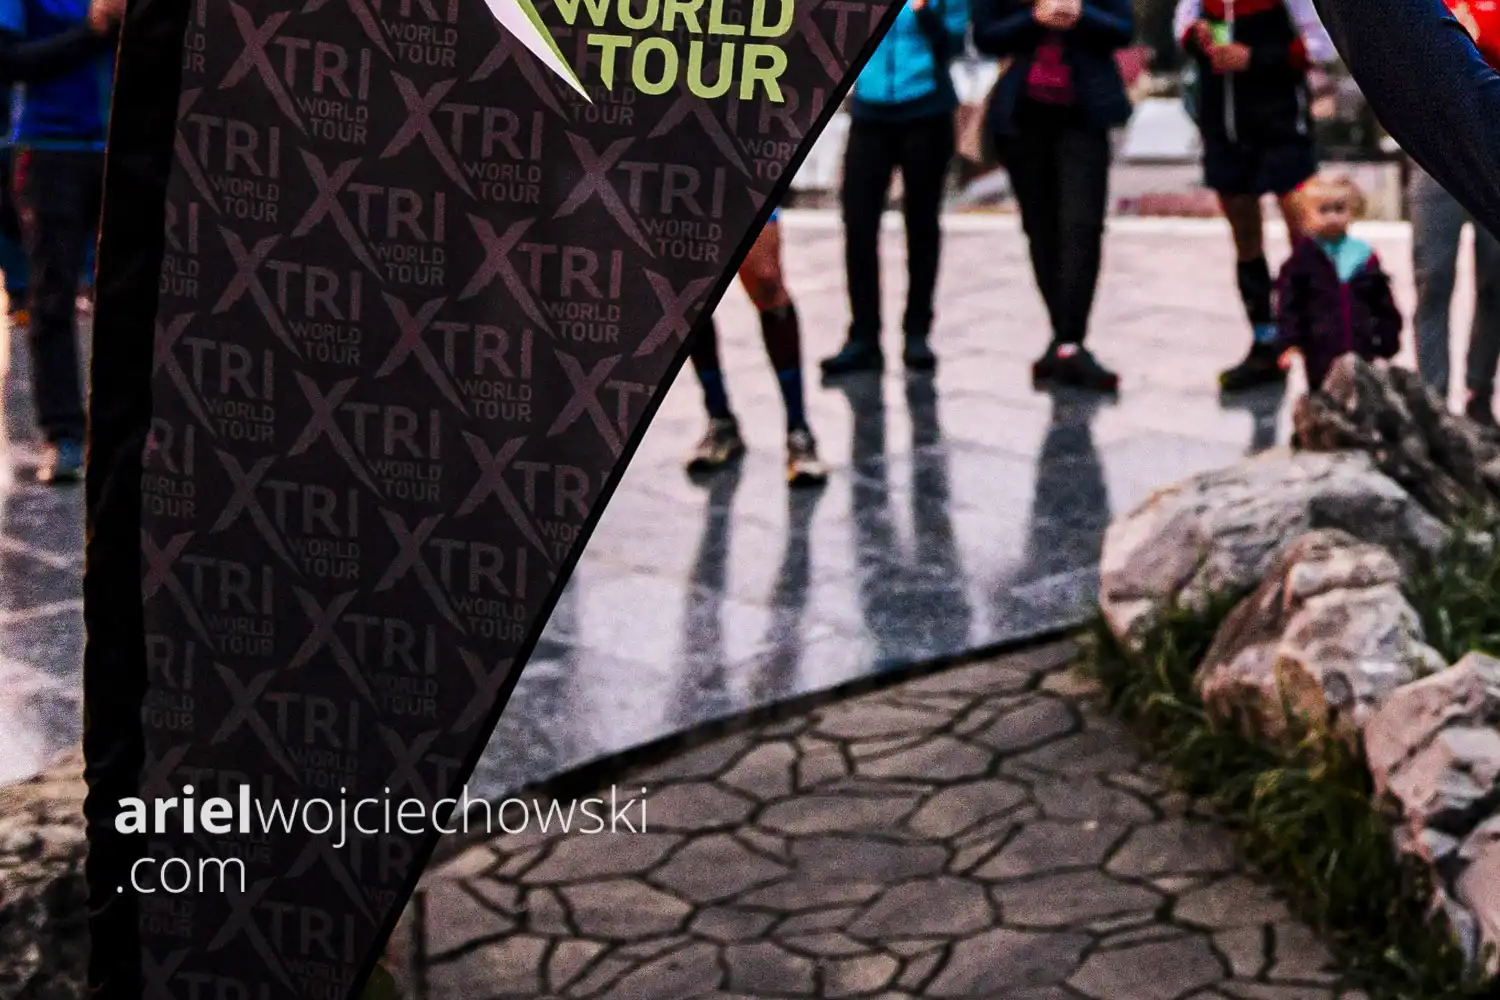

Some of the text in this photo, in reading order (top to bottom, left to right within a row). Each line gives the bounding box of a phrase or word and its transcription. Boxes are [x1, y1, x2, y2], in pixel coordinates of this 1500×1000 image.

[381, 20, 459, 48] WORLD
[394, 42, 457, 68] TOUR
[217, 0, 372, 139] XTRI
[587, 32, 789, 104] TOUR
[296, 97, 369, 124] WORLD
[569, 102, 635, 126] TOUR
[309, 120, 367, 145] TOUR
[378, 68, 544, 203] XTRI
[463, 160, 542, 184] WORLD
[208, 172, 280, 200] WORLD
[476, 181, 540, 205] TOUR
[552, 129, 726, 259] XTRI
[220, 196, 279, 223] TOUR
[290, 150, 446, 283] XTRI
[641, 217, 722, 241] WORLD
[366, 240, 445, 265] WORLD
[655, 239, 720, 262] TOUR
[384, 261, 445, 287] TOUR
[458, 211, 623, 340] XTRI
[210, 222, 362, 360] XTRI
[542, 301, 621, 323] WORLD
[287, 320, 362, 344] WORLD
[558, 321, 620, 343] TOUR
[304, 342, 361, 365] TOUR
[373, 290, 533, 420] XTRI
[455, 377, 533, 401] WORLD
[203, 398, 275, 423] WORLD
[474, 398, 532, 423] TOUR
[219, 419, 275, 442] TOUR
[287, 368, 441, 500] XTRI
[368, 457, 442, 482] WORLD
[382, 478, 440, 501] TOUR
[454, 429, 592, 565] XTR
[209, 445, 358, 578] XTRI
[287, 536, 360, 559] WORLD
[302, 557, 360, 580] TOUR
[373, 505, 527, 636] XTRI
[451, 596, 527, 620] WORLD
[207, 613, 274, 637] WORLD
[468, 616, 525, 641] TOUR
[218, 632, 274, 655] TOUR
[286, 584, 437, 714] XTRI
[368, 672, 438, 697] WORLD
[379, 693, 437, 717] TOUR
[209, 661, 358, 783] XTRI
[287, 747, 357, 772] WORLD
[302, 770, 356, 789] TOUR
